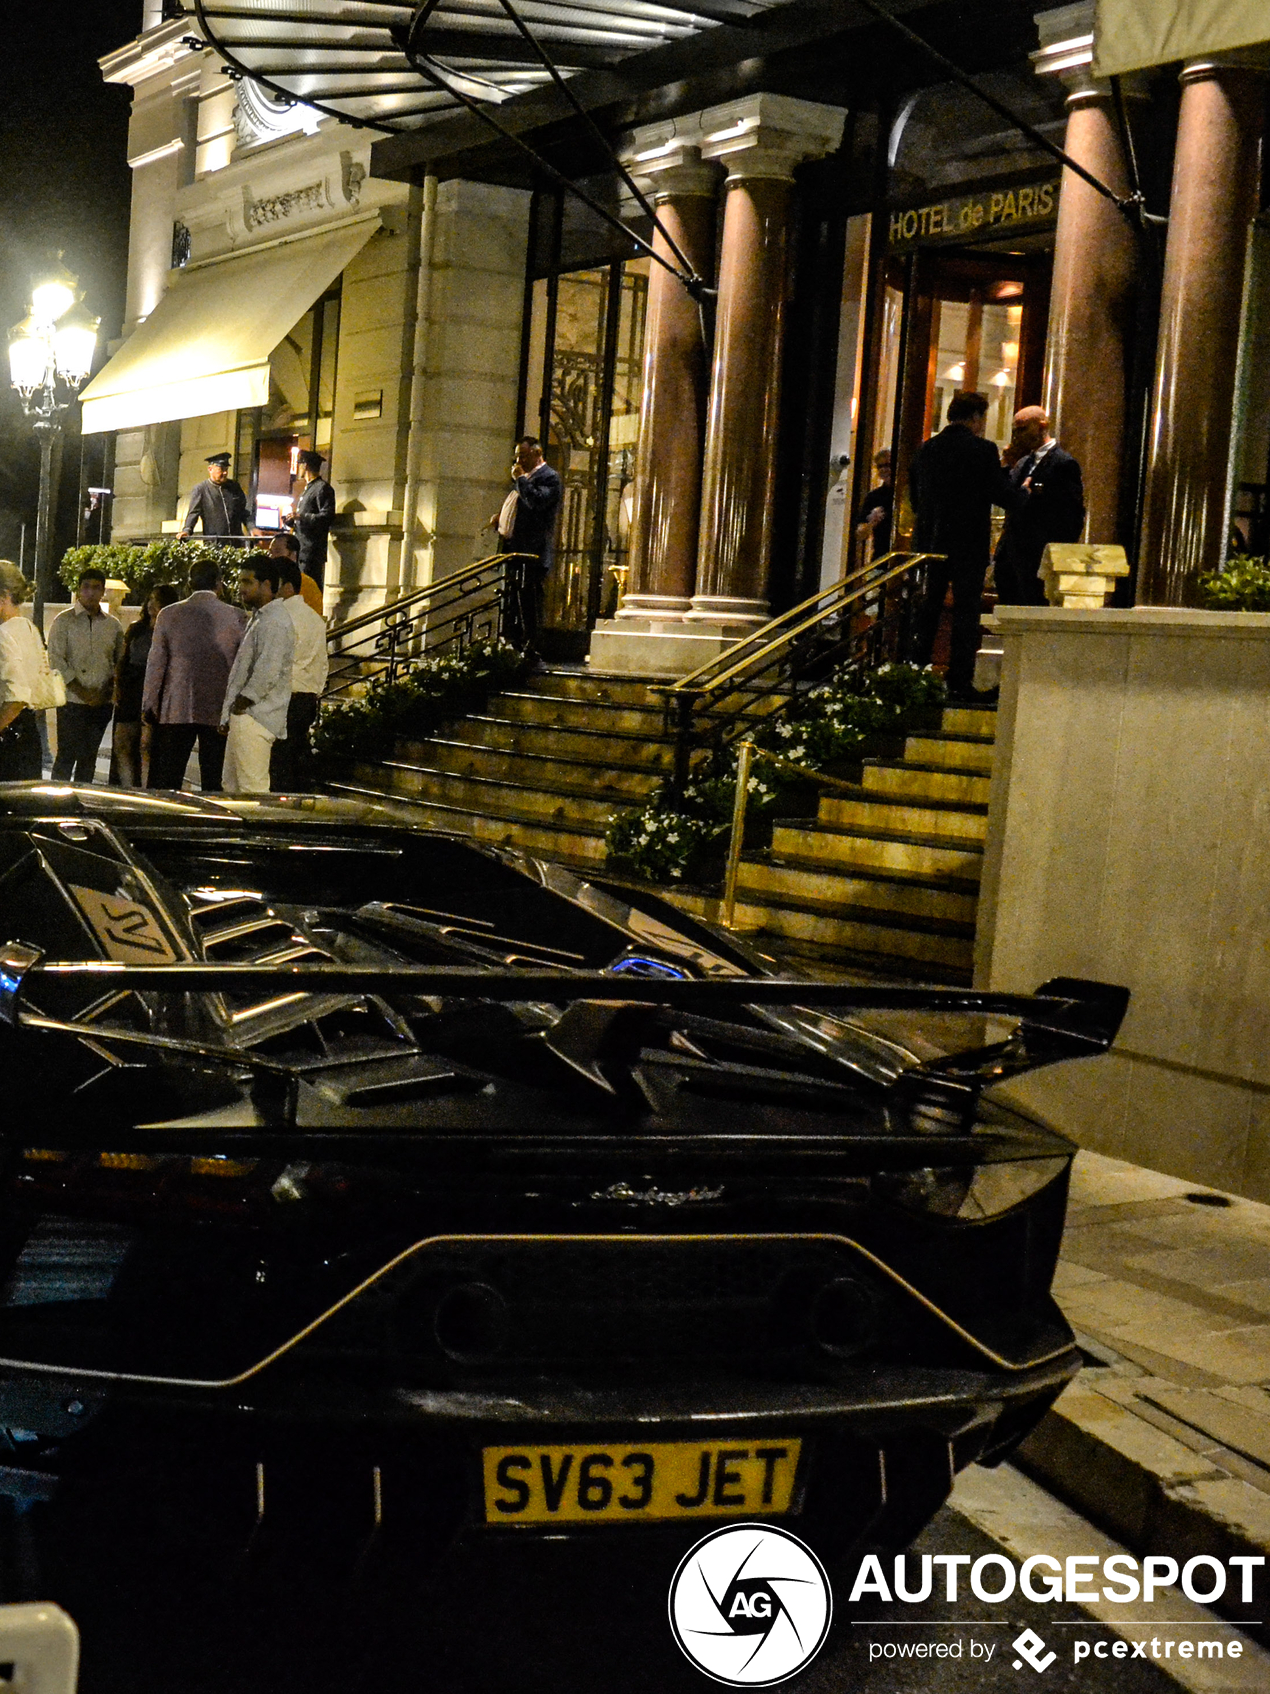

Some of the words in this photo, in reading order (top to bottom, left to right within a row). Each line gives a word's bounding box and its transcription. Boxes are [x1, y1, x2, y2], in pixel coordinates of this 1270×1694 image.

[889, 204, 956, 244] HOTEL
[960, 200, 984, 230] de
[989, 184, 1054, 225] PARIS
[494, 1452, 655, 1514] SV63
[675, 1447, 788, 1509] JET
